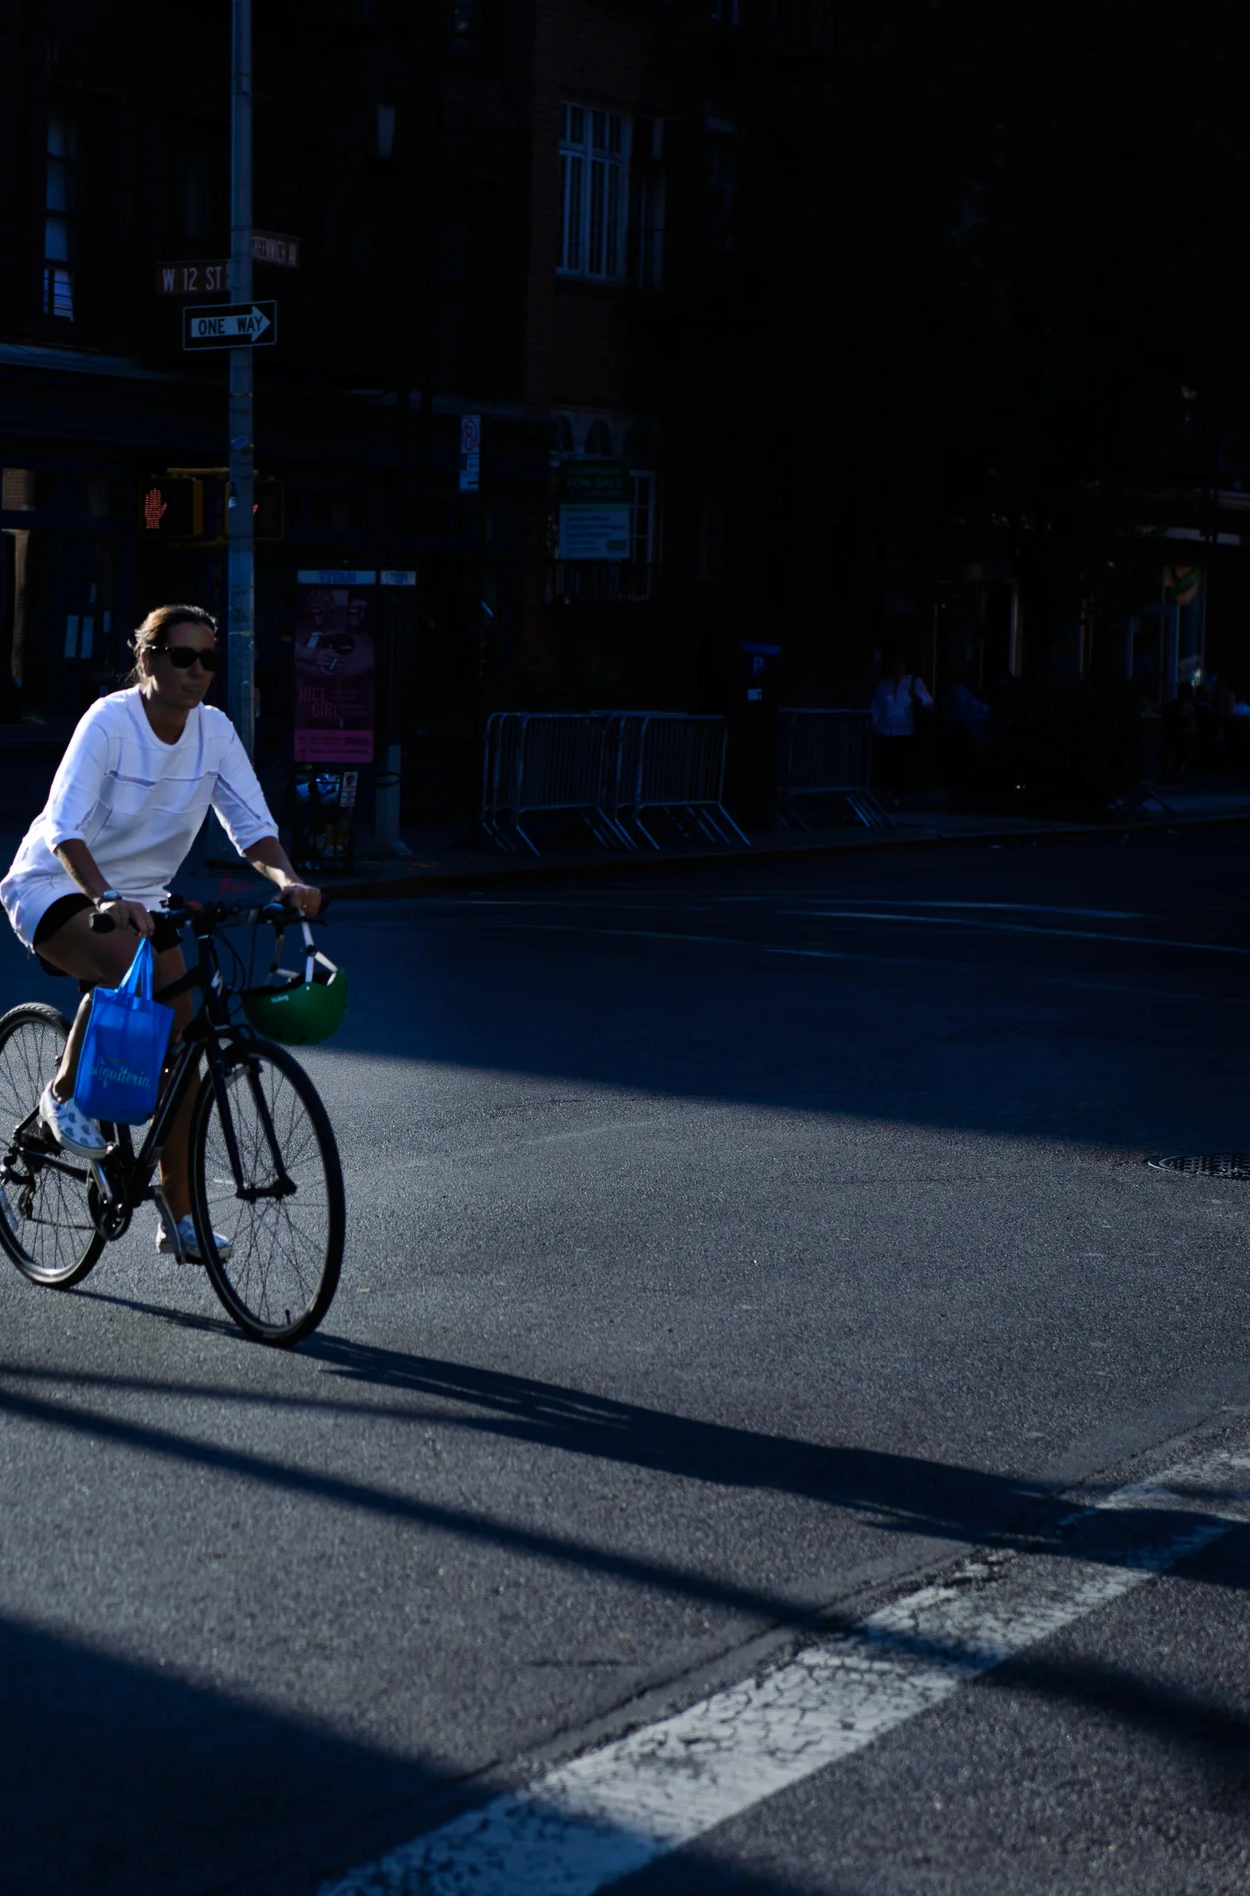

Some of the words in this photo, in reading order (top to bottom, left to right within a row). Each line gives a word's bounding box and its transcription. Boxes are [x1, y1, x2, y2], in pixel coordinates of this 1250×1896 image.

[162, 268, 175, 292] W
[183, 266, 198, 291] 12
[205, 266, 224, 290] ST
[198, 319, 225, 336] ONE
[237, 315, 263, 333] WAY
[318, 572, 357, 584] TITAN
[753, 656, 765, 675] P
[298, 686, 327, 703] NICE
[311, 702, 340, 719] GIRL
